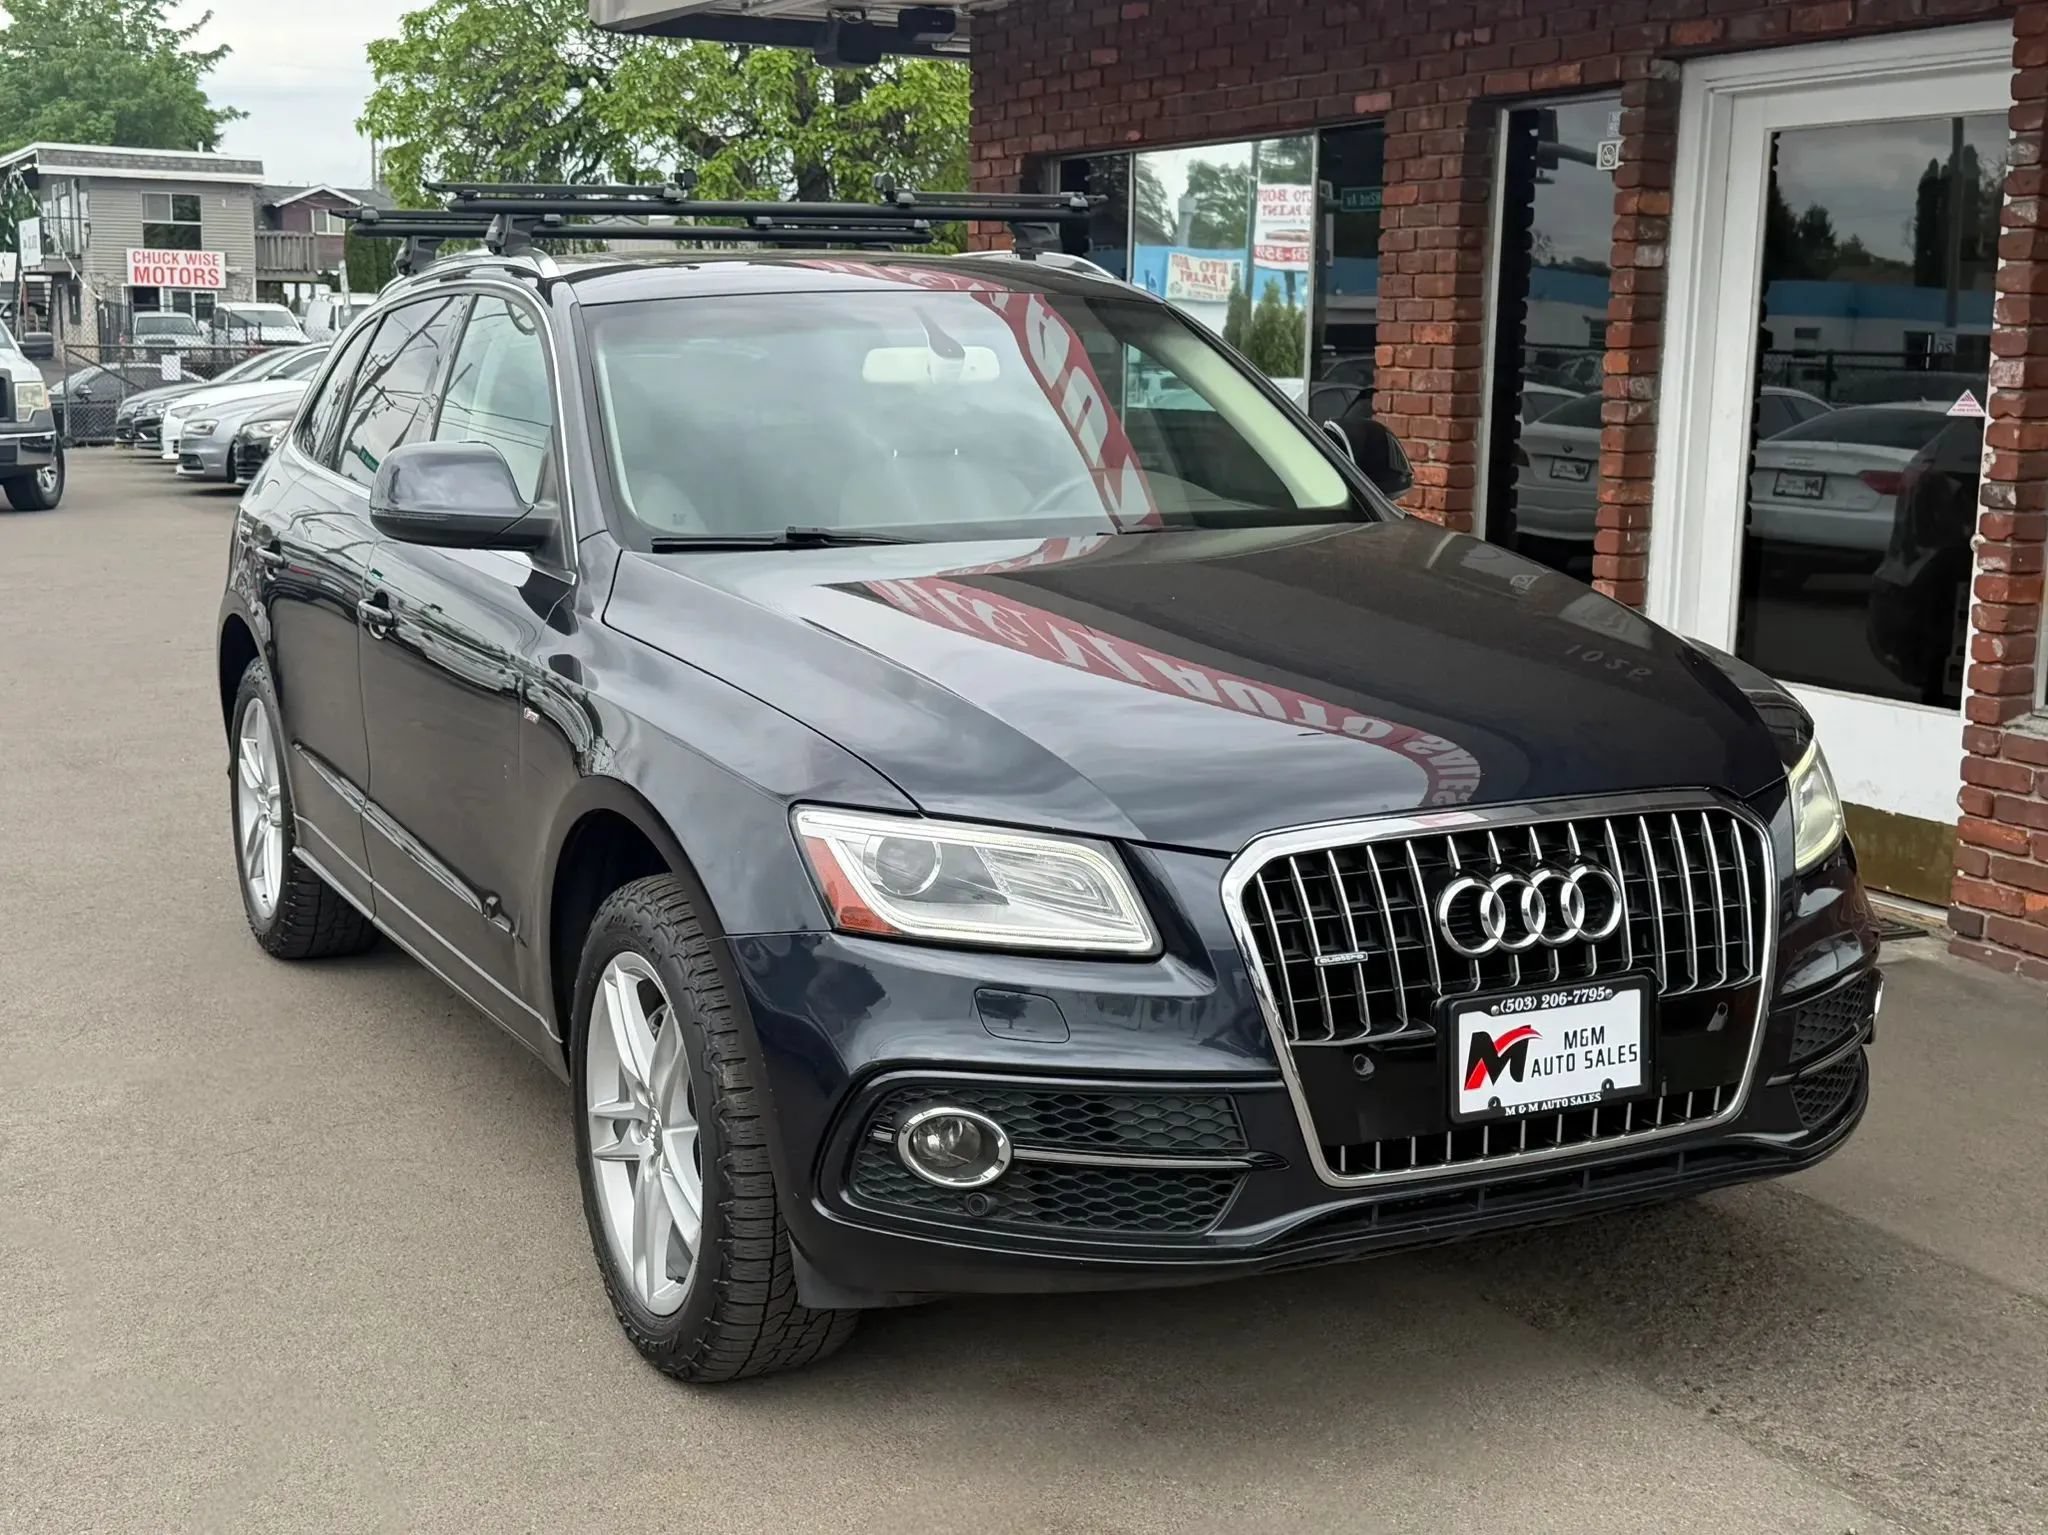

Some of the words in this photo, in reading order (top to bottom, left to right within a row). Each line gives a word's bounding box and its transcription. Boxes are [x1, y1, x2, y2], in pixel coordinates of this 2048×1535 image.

[132, 250, 180, 266] CHUCK
[184, 253, 220, 266] WISE
[134, 266, 220, 286] MOTORS
[1499, 995, 1537, 1014] (503)
[1541, 985, 1606, 1009] 206-7795
[1563, 1025, 1605, 1051] M&M
[1531, 1053, 1576, 1078] AUTO
[1584, 1043, 1638, 1069] SALES
[1504, 1105, 1517, 1117] M
[1518, 1103, 1527, 1114] &
[1528, 1101, 1540, 1113] M
[1541, 1097, 1569, 1111] AUTO
[1570, 1092, 1602, 1107] SALES
